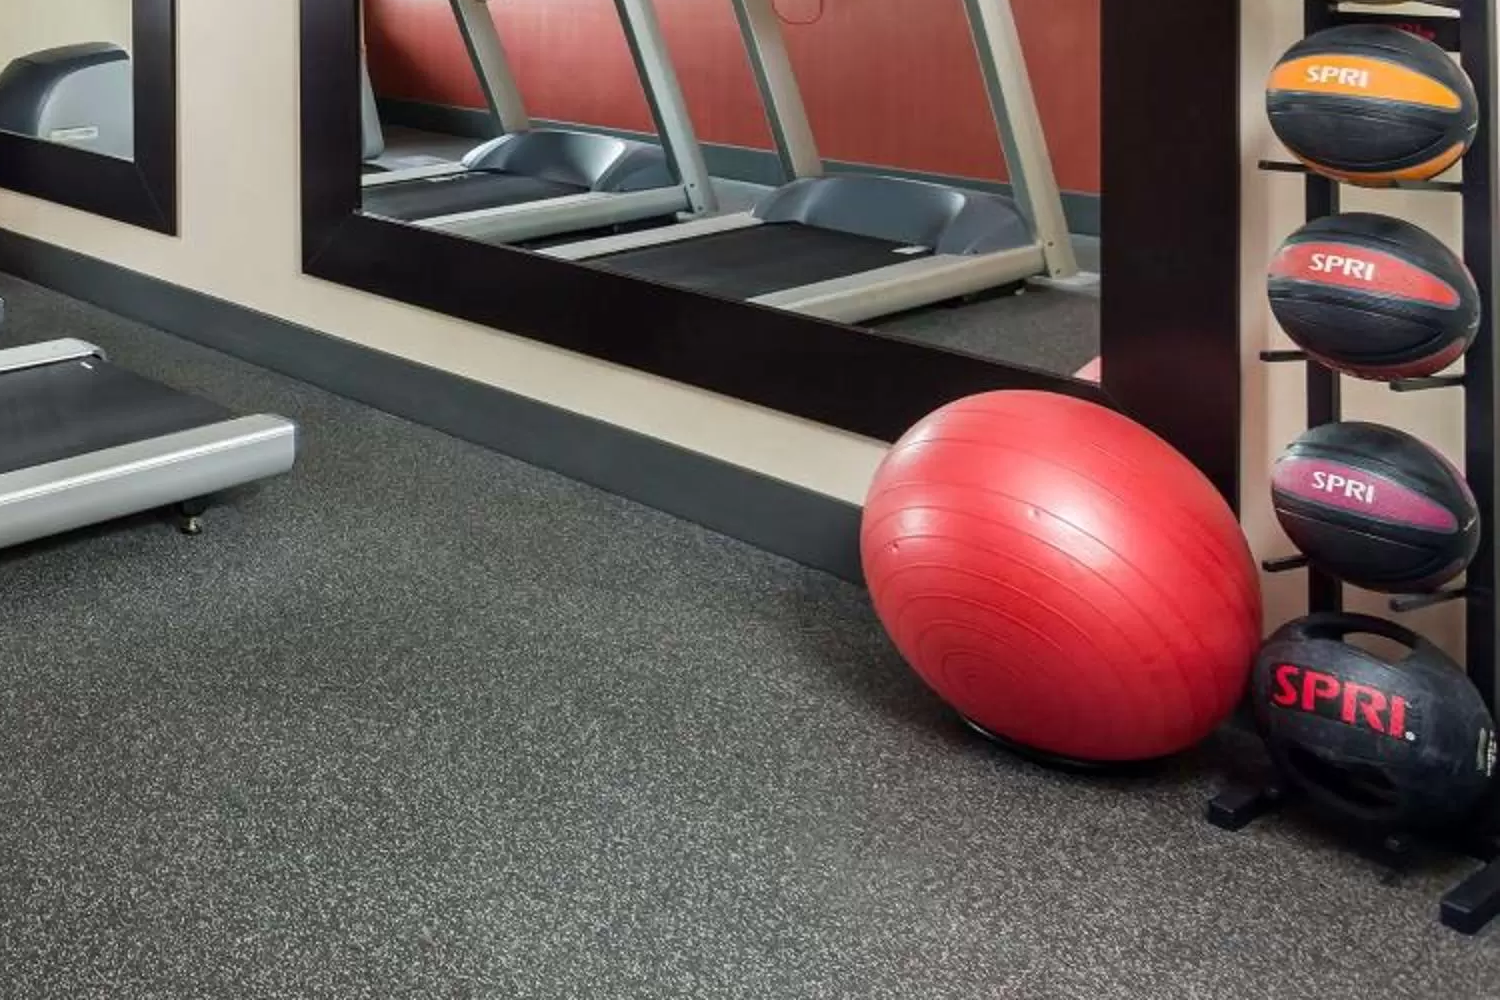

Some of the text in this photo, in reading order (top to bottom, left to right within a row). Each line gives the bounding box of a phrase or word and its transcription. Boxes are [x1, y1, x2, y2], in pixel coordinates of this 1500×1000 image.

[1305, 64, 1369, 88] SPRI
[1308, 253, 1375, 281] SPRI
[1311, 471, 1375, 504] SPRI
[1273, 664, 1406, 738] SPRI
